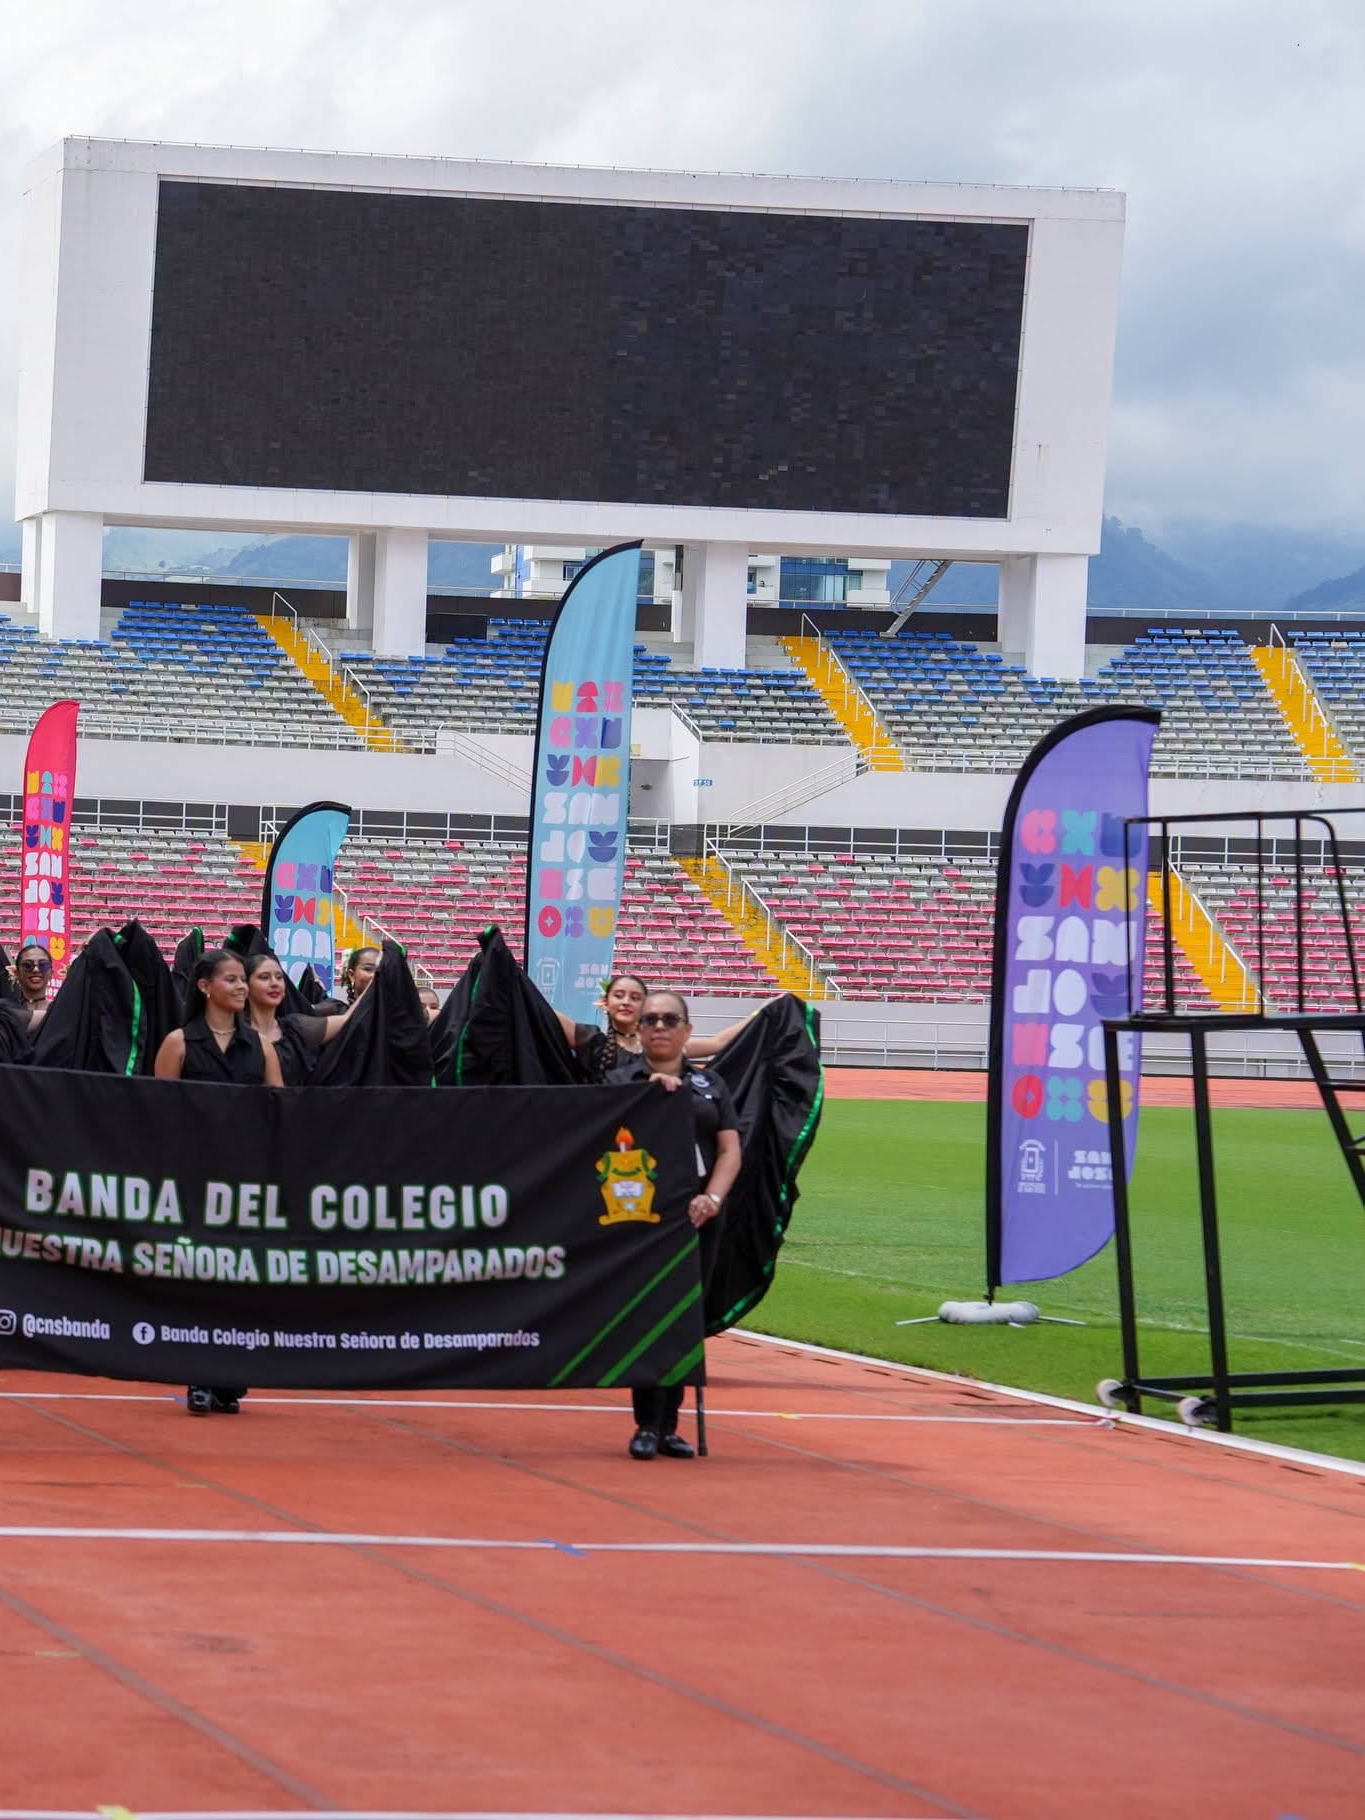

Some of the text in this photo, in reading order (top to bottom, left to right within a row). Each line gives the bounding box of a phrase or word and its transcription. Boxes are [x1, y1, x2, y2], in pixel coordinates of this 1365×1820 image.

[25, 1168, 508, 1230] BANDA DEL COLEGIO
[132, 1236, 259, 1283] SEÑORA
[266, 1249, 309, 1284] DE
[317, 1246, 566, 1285] DESAMPARADOS
[22, 1313, 111, 1340] @cnsbanda
[161, 1325, 540, 1351] Banda Colegio Nuestra Señora de Desamparados
